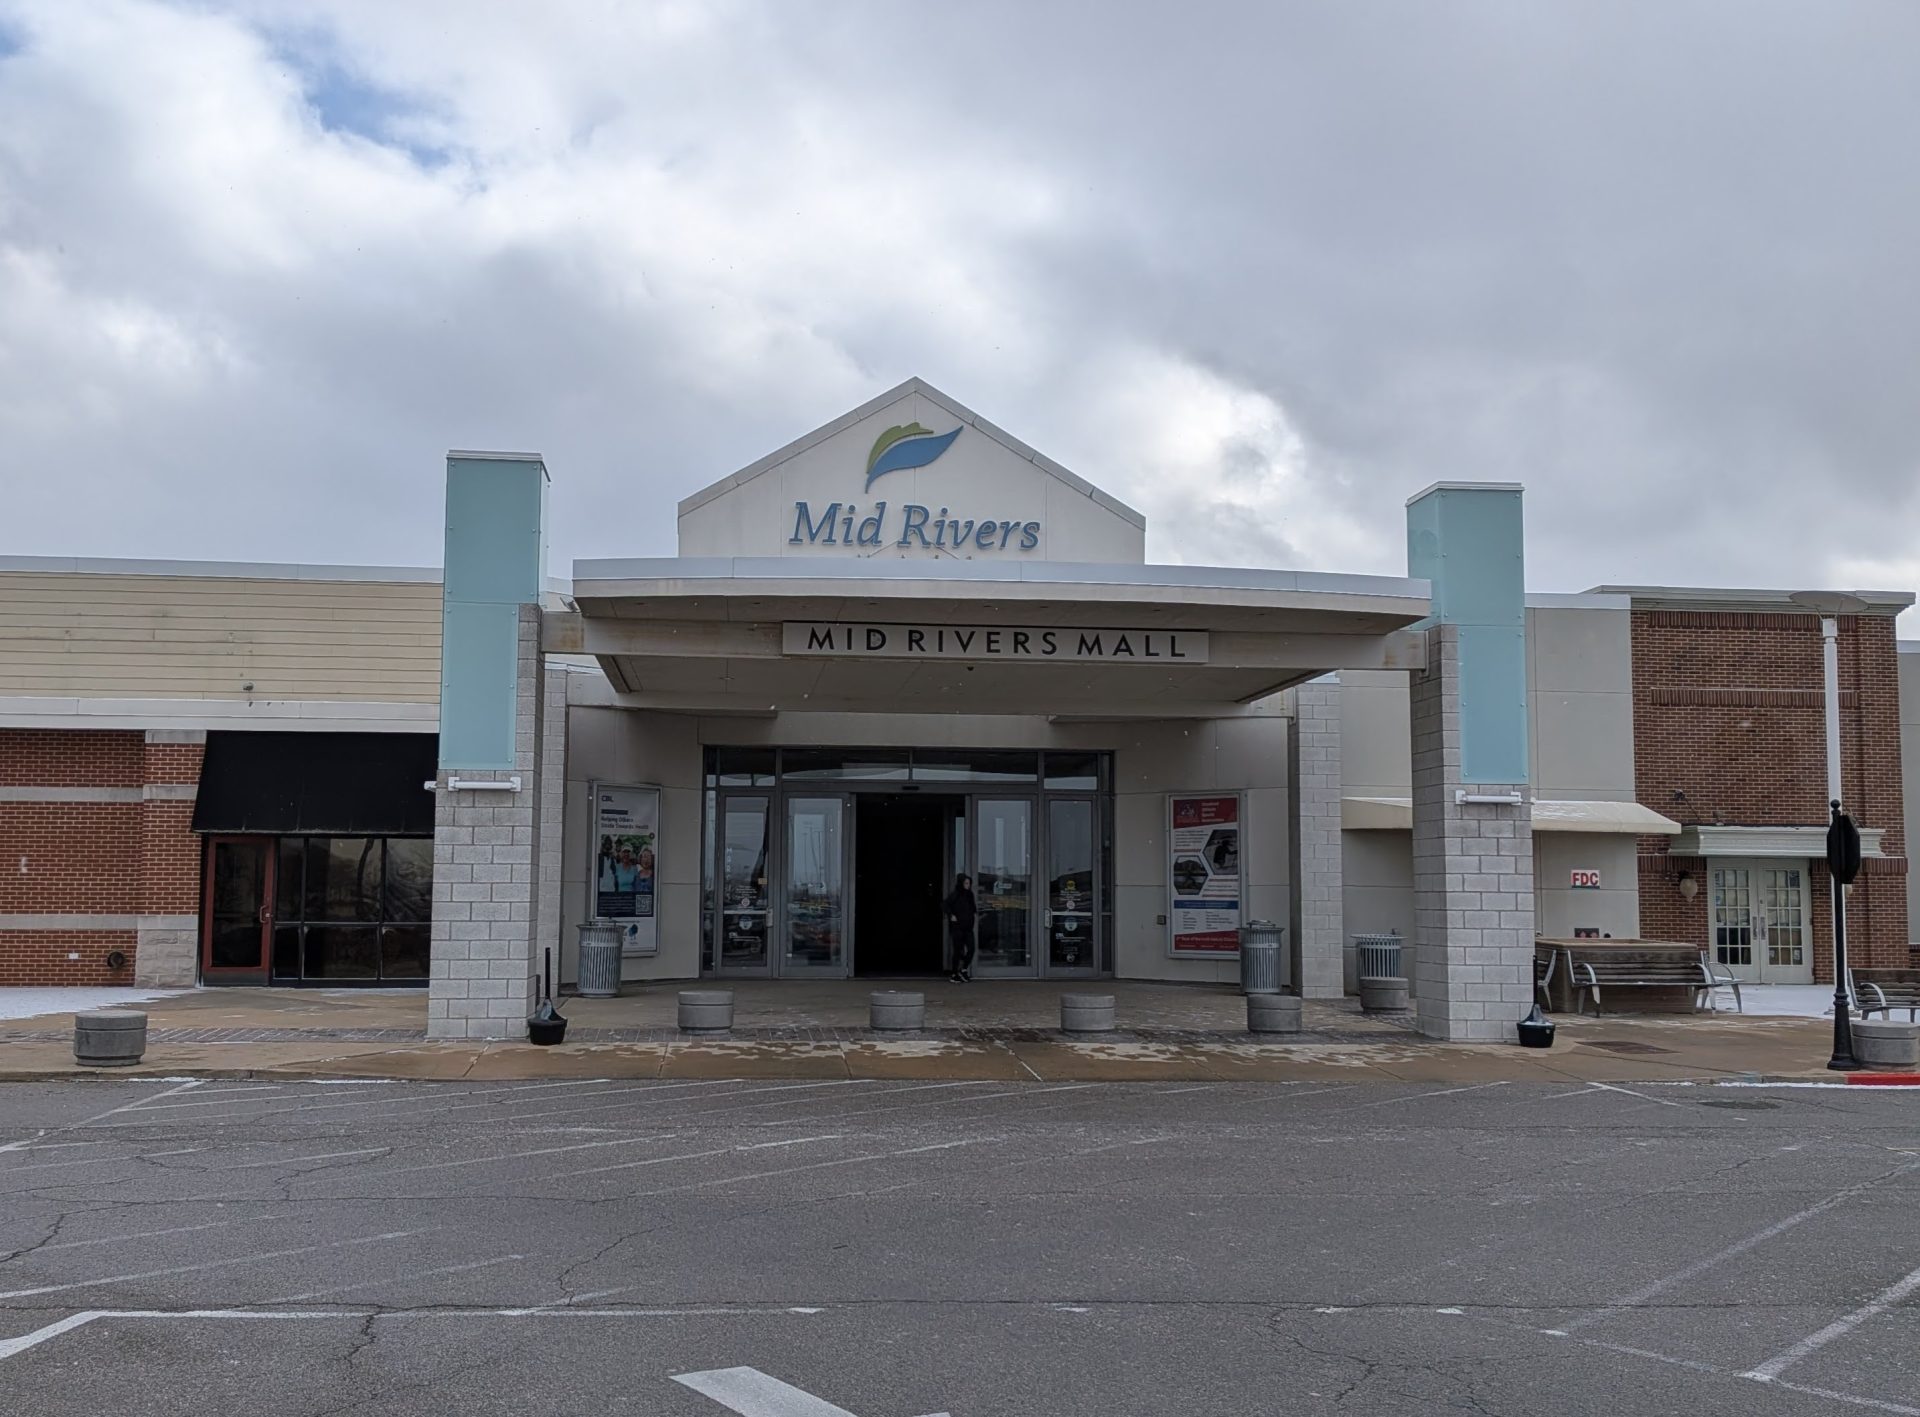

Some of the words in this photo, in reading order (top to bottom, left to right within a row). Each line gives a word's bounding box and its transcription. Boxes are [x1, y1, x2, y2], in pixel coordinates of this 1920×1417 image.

[788, 501, 887, 545] Mid
[897, 504, 1041, 550] Rivers
[807, 626, 887, 651] MID
[908, 629, 1057, 655] RIVERS
[1077, 633, 1186, 658] MALL
[1572, 872, 1599, 886] FDC
